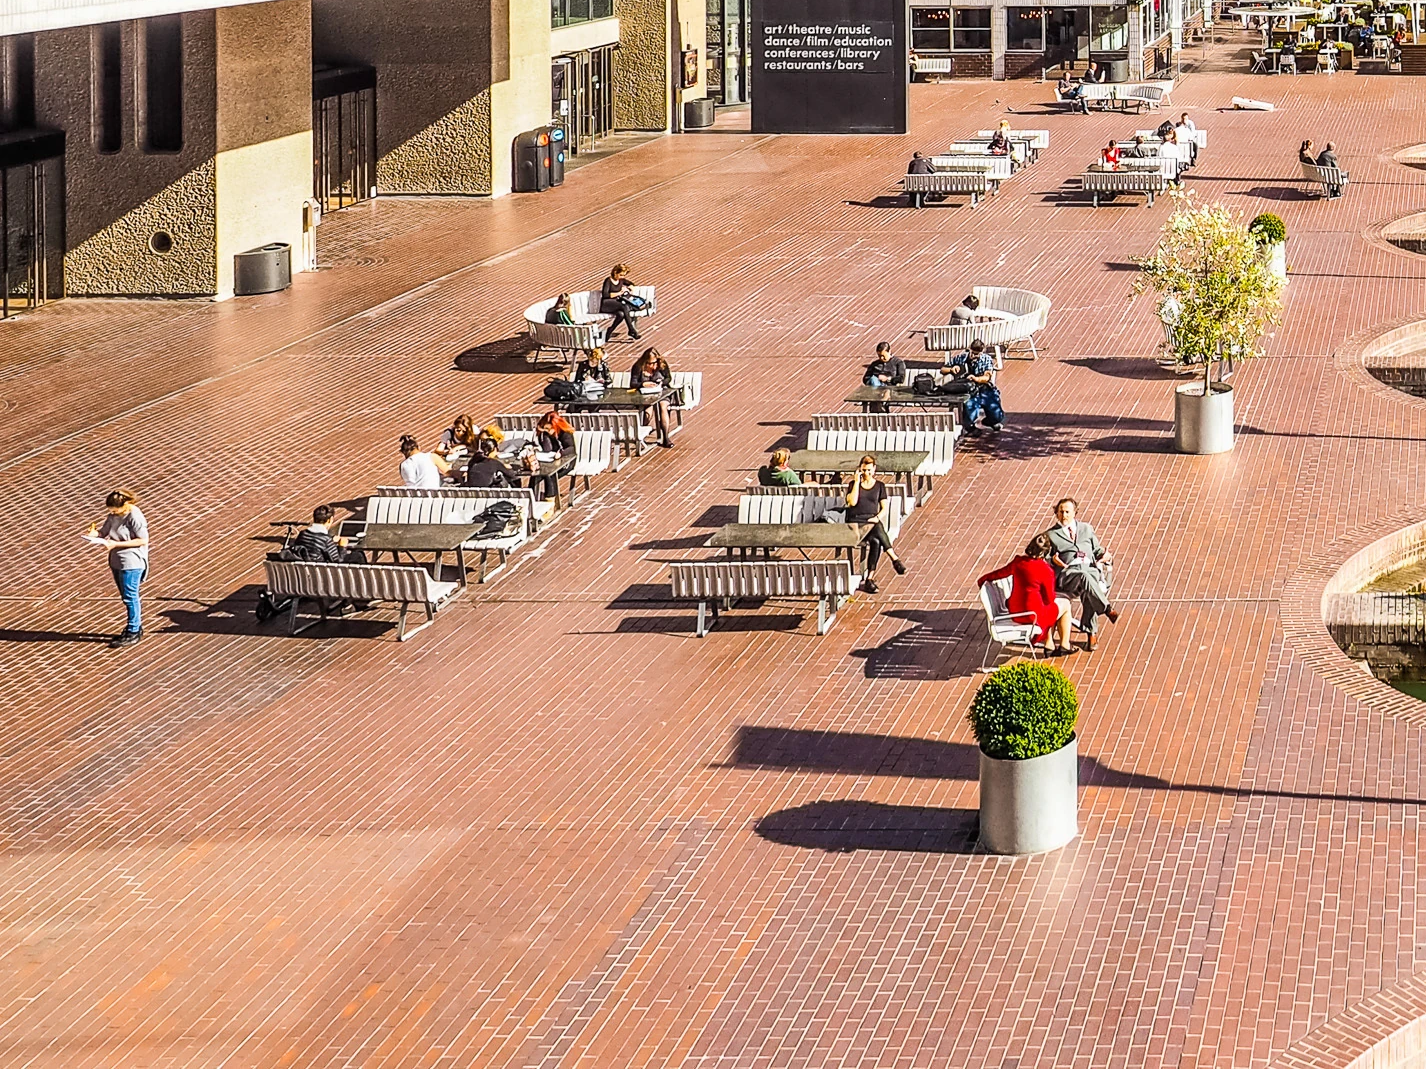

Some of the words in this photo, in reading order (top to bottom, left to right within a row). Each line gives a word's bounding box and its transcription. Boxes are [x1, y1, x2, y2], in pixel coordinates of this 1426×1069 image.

[764, 24, 871, 34] art/theatre/music
[764, 36, 893, 46] dance/film/education
[764, 48, 881, 60] conferences/library
[764, 60, 865, 70] restaurants/bars
